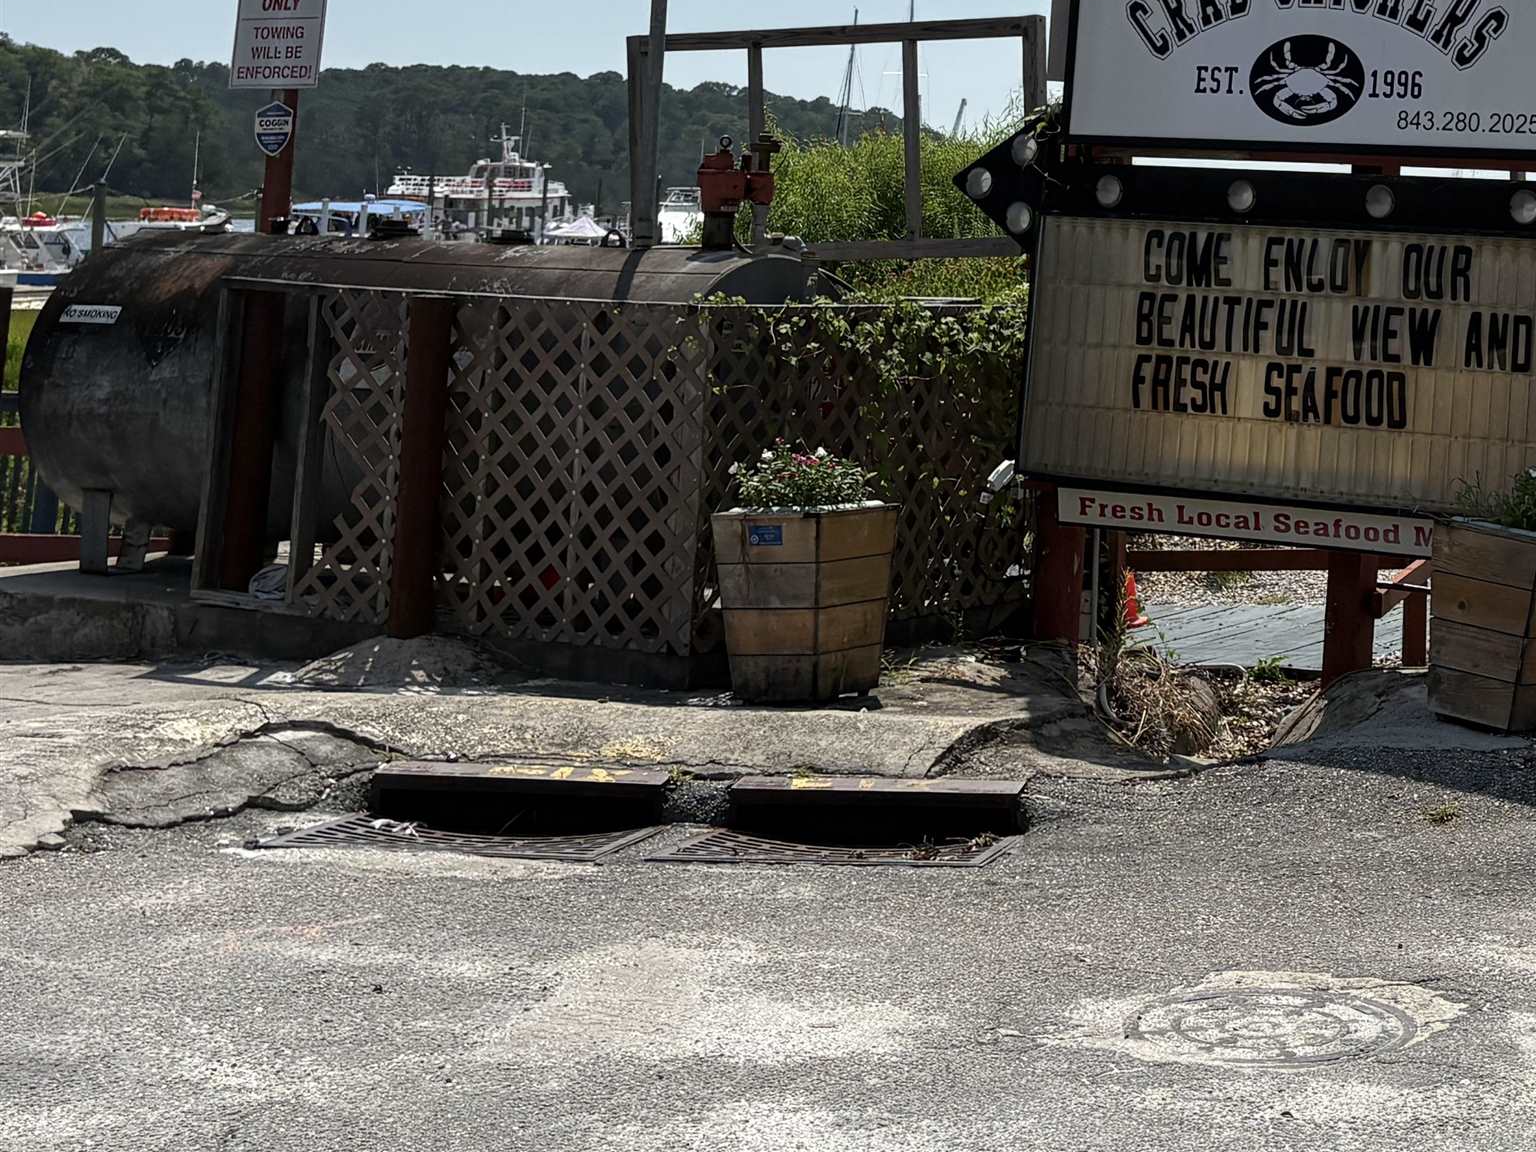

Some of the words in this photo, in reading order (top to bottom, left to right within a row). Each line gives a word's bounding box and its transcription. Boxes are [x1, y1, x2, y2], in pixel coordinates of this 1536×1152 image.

[251, 46, 281, 60] WILL
[285, 45, 303, 59] BE
[254, 26, 305, 40] TOWING
[237, 65, 312, 79] ENFORCED!
[1194, 66, 1245, 95] EST.
[1368, 70, 1424, 99] 1996
[1144, 229, 1232, 288] COME
[1402, 244, 1473, 302] OUR
[1135, 291, 1315, 358] BEAUTIFUL
[1351, 306, 1442, 367] VIEW
[1464, 312, 1533, 373] AND
[1132, 354, 1231, 415] FRESH
[1263, 362, 1408, 430] SEAFOOD
[1078, 497, 1165, 523] Fresh
[1177, 505, 1262, 532] Local
[1273, 513, 1401, 545] Seafood
